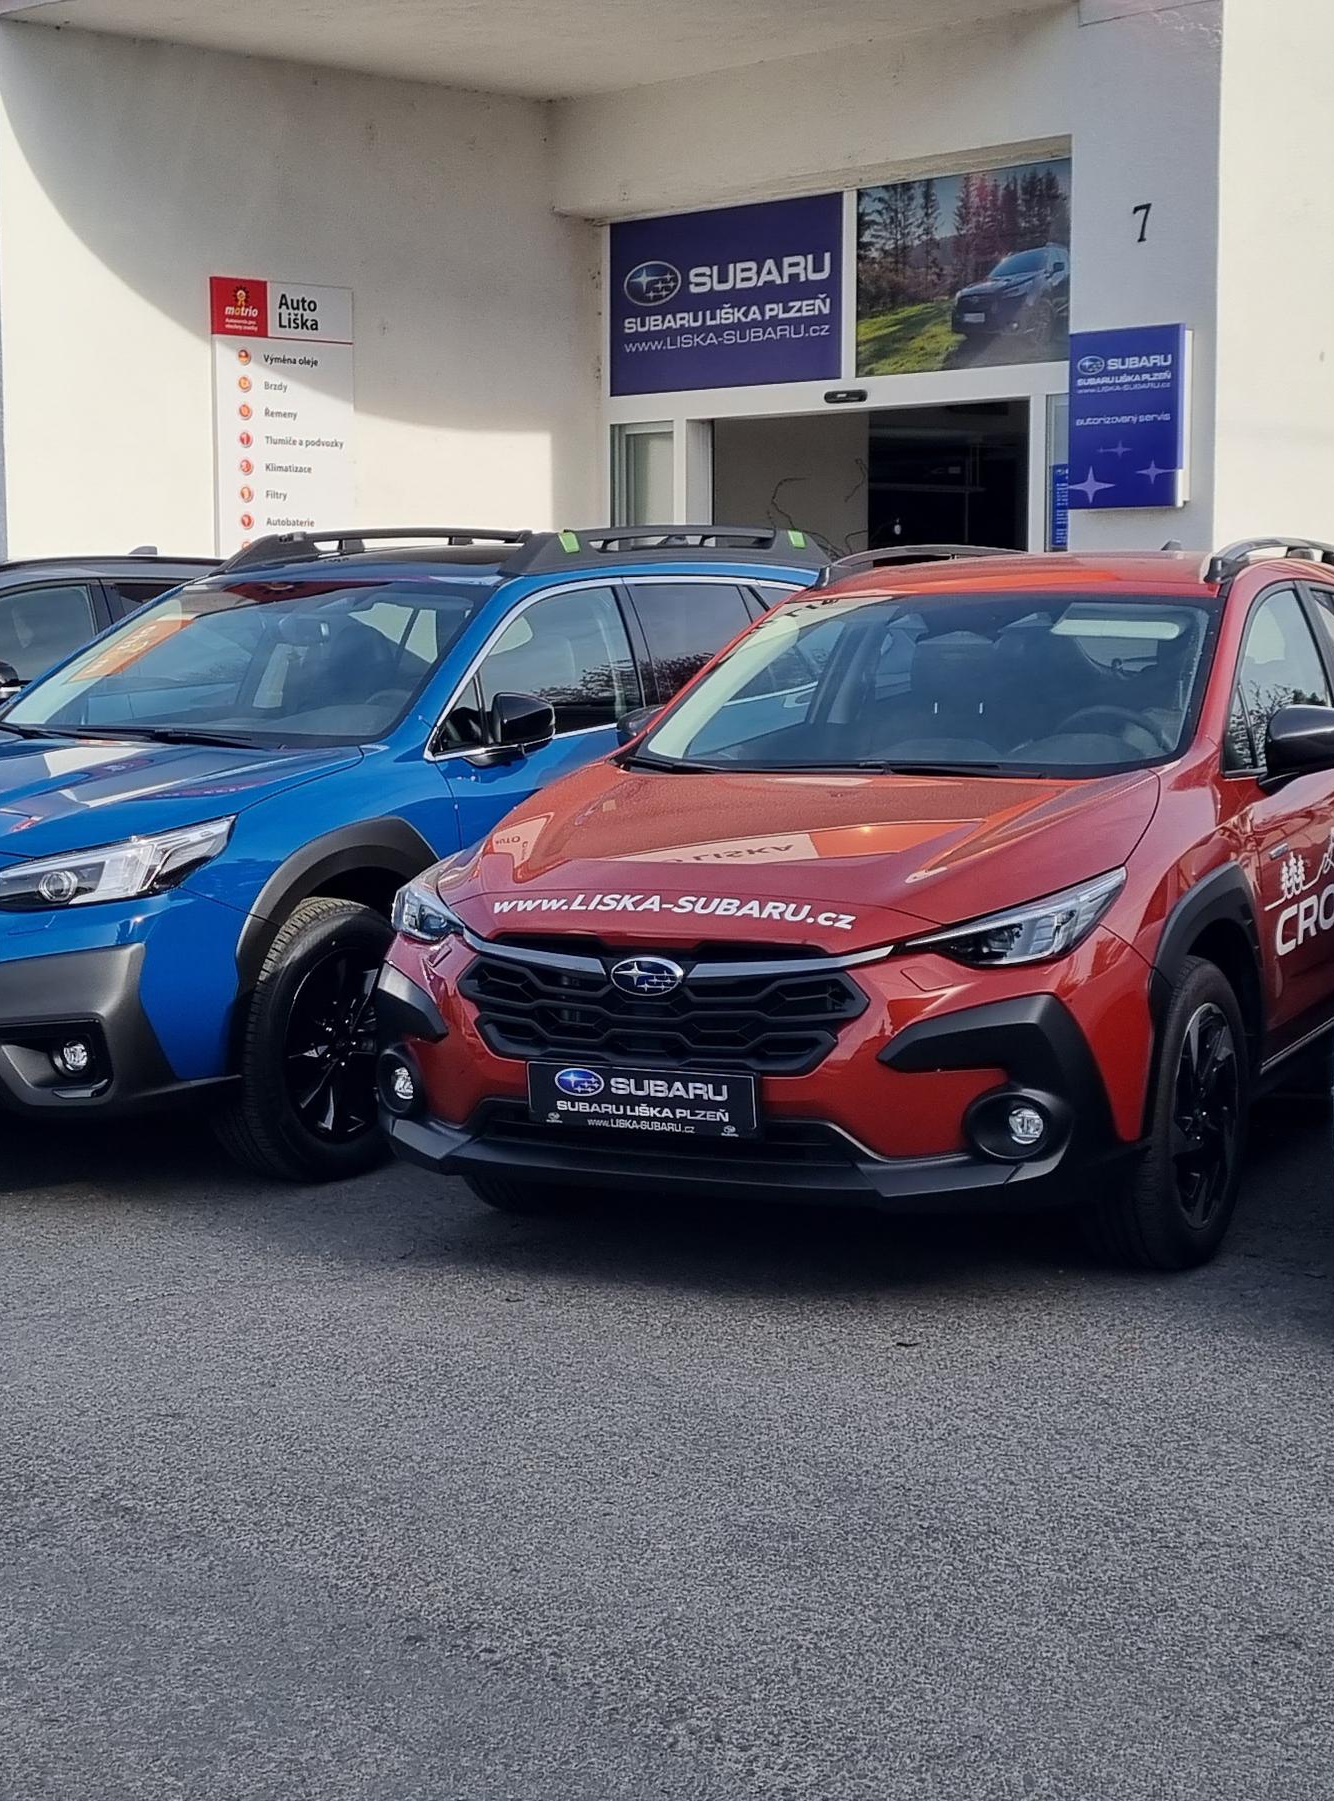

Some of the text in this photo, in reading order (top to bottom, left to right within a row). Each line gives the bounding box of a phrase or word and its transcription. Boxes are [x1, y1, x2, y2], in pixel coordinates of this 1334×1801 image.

[1132, 203, 1153, 242] 7
[688, 251, 832, 294] SUBARU
[224, 305, 258, 317] motrio
[278, 293, 318, 312] Auto
[278, 311, 319, 331] Liška
[624, 293, 831, 334] SUBARU LIŠKA PLZEŇ
[624, 323, 831, 353] www.LISKA-SUBARU.cz
[263, 353, 319, 367] Výměna oleje
[1107, 353, 1172, 370] SUBARU
[264, 381, 288, 393] Brzdy
[1077, 376, 1114, 387] SUBARU
[1138, 411, 1171, 422] servis
[264, 434, 345, 450] Tlumiče a podvozky
[265, 463, 313, 474] Klimatizace
[265, 489, 288, 502] Filtry
[266, 516, 315, 528] Autobaterie
[493, 893, 857, 930] www.LISKA-SUBARU.cz
[610, 1076, 729, 1102] SUBARU
[557, 1100, 730, 1123] SUBARU LIŠKA PLZEŇ
[587, 1118, 696, 1135] www.LISKA-SUBARU.cz
